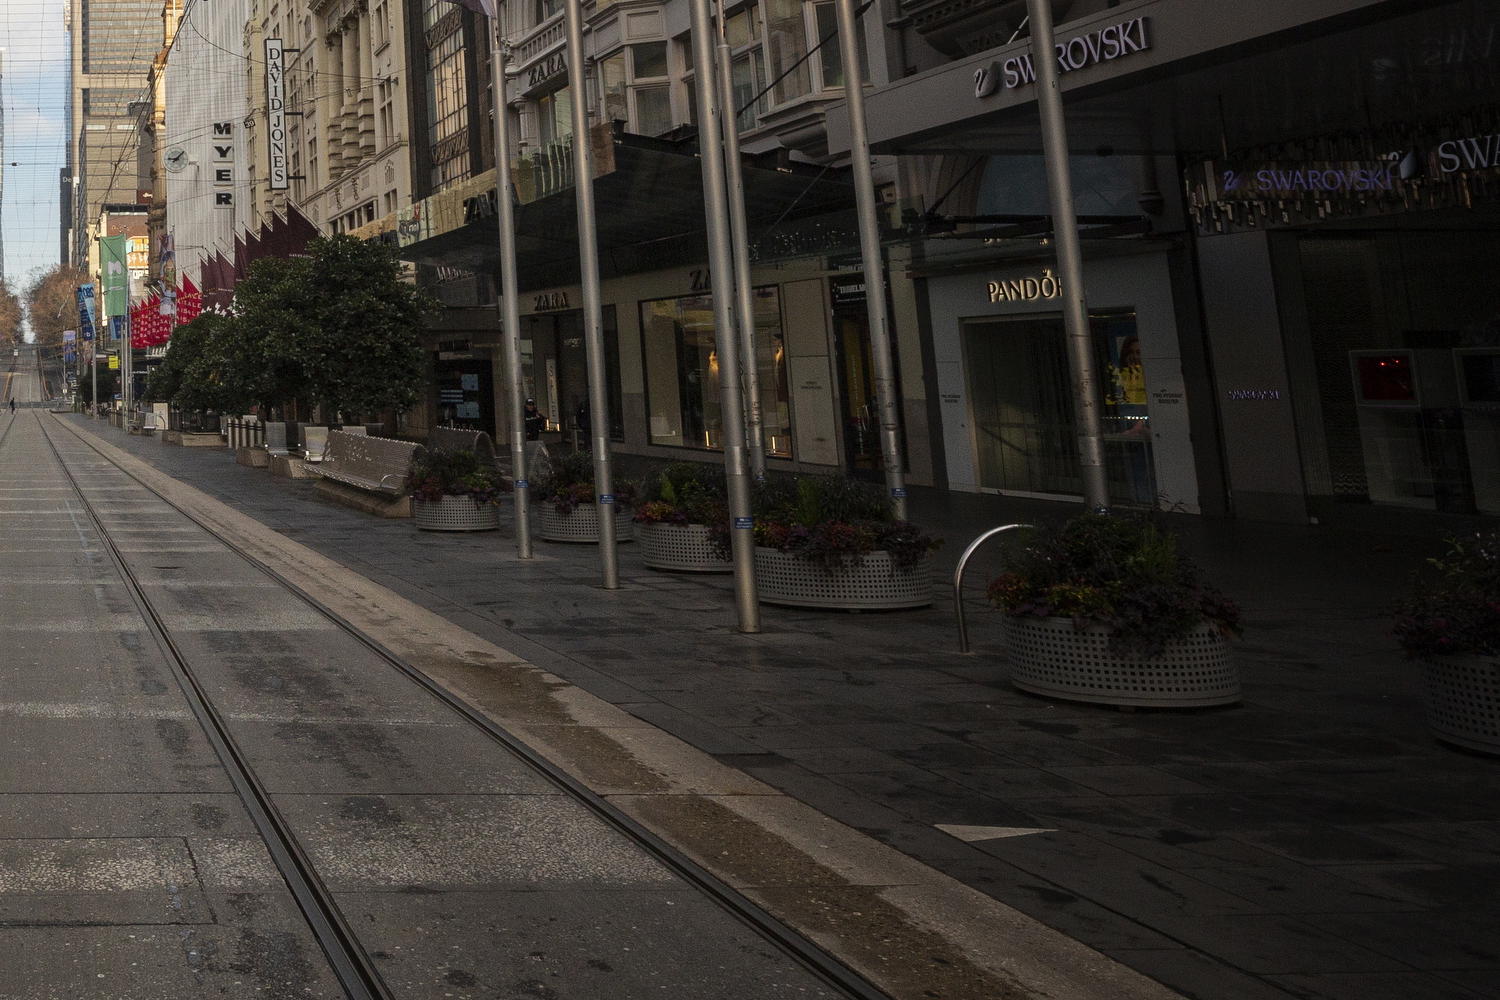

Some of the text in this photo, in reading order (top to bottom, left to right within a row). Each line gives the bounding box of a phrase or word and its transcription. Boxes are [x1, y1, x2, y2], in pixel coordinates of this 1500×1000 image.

[1003, 16, 1150, 90] SWROVSKI
[244, 119, 256, 129] 39
[269, 47, 284, 183] DAVID JONES
[213, 122, 233, 206] MYER
[1255, 169, 1394, 192] SWAROVSKI
[534, 290, 571, 312] ZARA
[987, 272, 1063, 304] PANDO
[1227, 390, 1280, 401] SWAROVSKI
